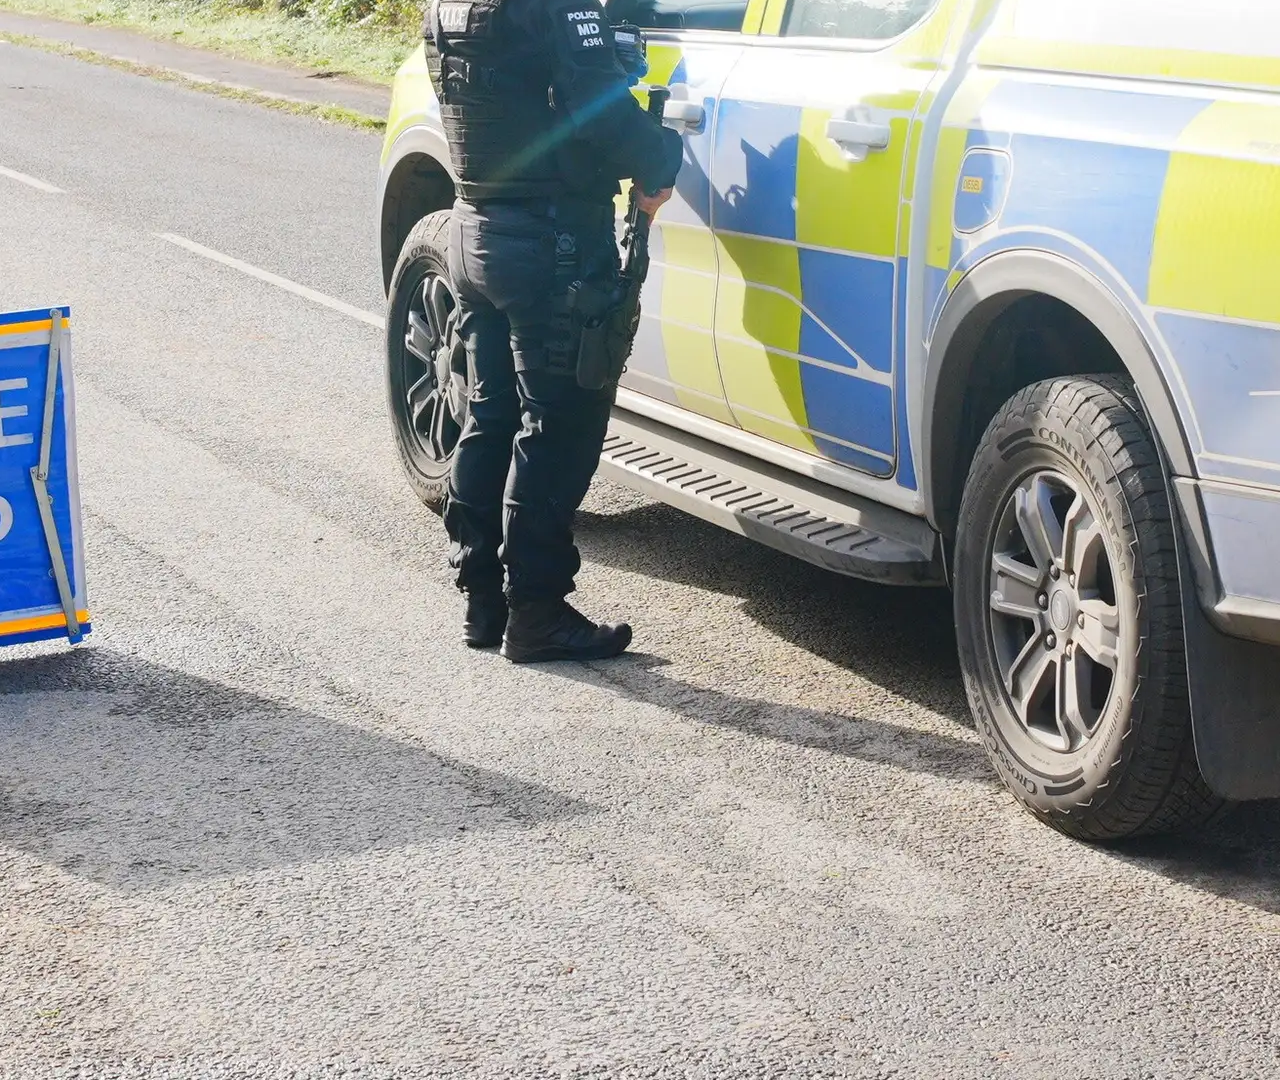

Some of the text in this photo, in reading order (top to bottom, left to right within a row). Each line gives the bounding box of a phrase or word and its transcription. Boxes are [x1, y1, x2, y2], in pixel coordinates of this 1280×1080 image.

[567, 11, 600, 21] POLICE
[577, 23, 600, 36] MD
[583, 37, 604, 47] 4361
[1038, 427, 1127, 582] CONTINENTAL
